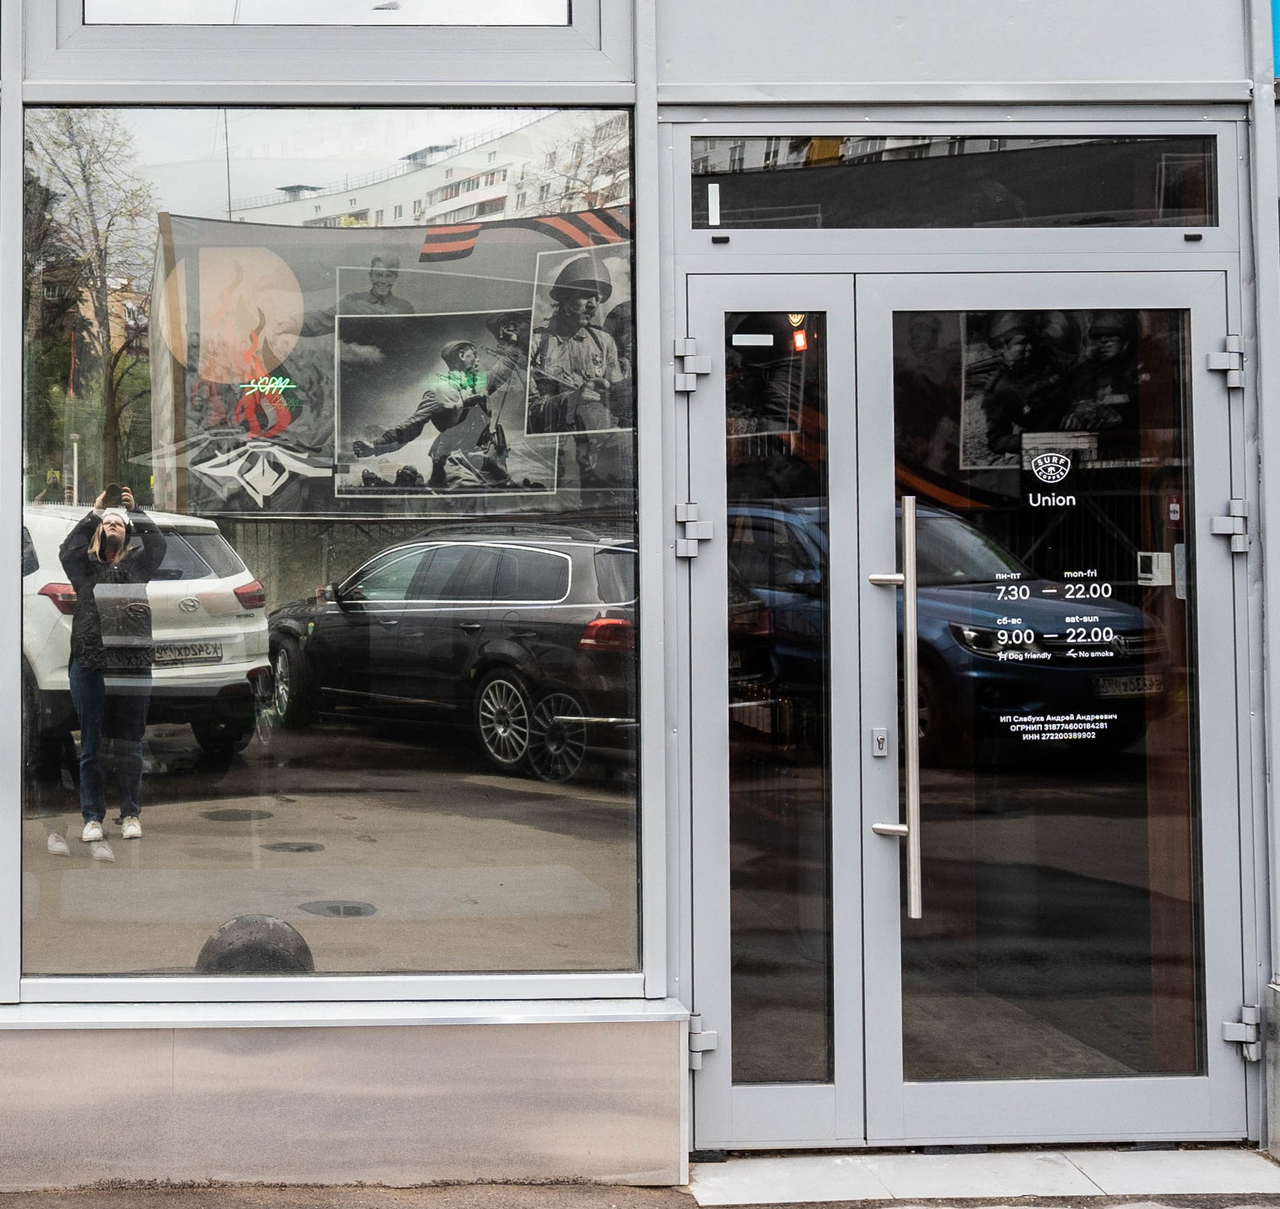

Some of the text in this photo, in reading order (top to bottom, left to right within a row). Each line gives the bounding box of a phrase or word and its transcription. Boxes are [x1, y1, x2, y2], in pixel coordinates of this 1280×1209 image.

[1037, 456, 1067, 466] SURF
[1028, 492, 1076, 507] Union
[995, 572, 1021, 580] пн-пт
[1064, 569, 1098, 578] mon-fri
[995, 585, 1031, 601] 7.30
[1064, 583, 1113, 599] 22.00
[996, 617, 1022, 625] сб-вс
[1065, 615, 1099, 623] sat-sun
[997, 629, 1035, 645] 9.00
[1065, 627, 1114, 643] 22.00
[1008, 652, 1052, 661] Dog friendly
[1090, 650, 1114, 658] smoke
[1045, 714, 1075, 722] Андрей
[1075, 713, 1118, 722] Андреевич
[1009, 722, 1108, 732] ОГРНИП 318774600184281
[1022, 731, 1096, 741] ИНН 272200389902
